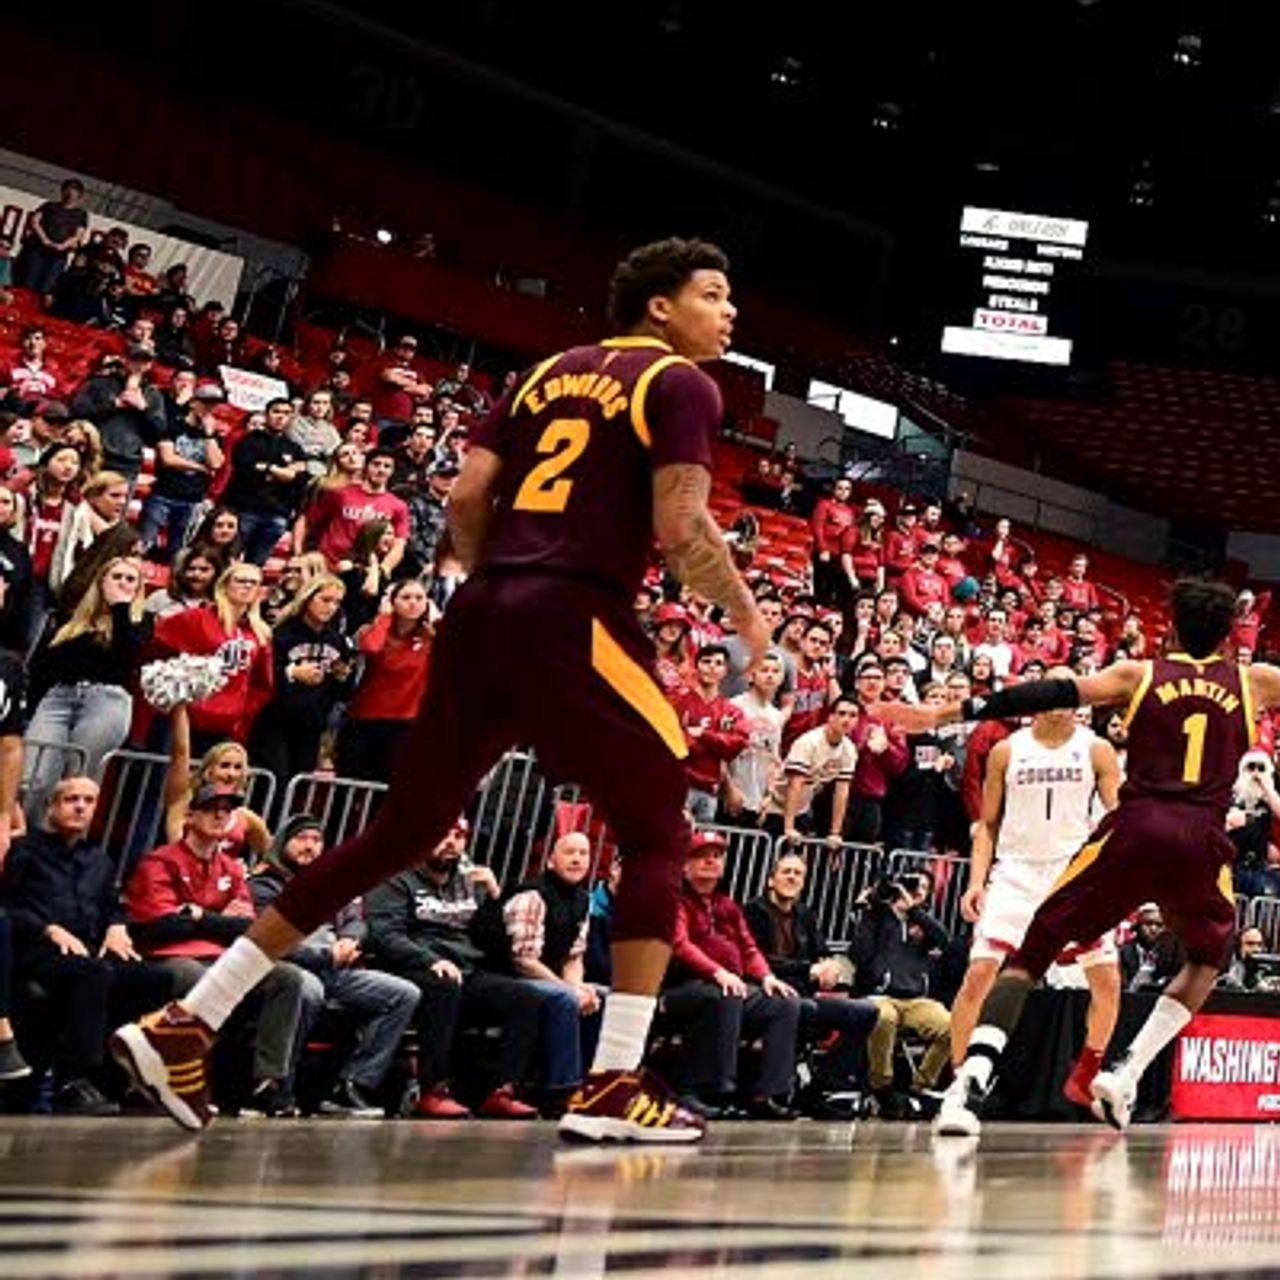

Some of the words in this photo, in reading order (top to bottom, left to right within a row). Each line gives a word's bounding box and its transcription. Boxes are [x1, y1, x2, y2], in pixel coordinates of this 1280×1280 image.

[979, 313, 1043, 332] TOTAL
[512, 418, 590, 513] 2
[1155, 677, 1240, 714] MARTIN
[1182, 712, 1209, 785] 1
[1017, 766, 1083, 787] COUGARS
[1045, 787, 1053, 821] 1
